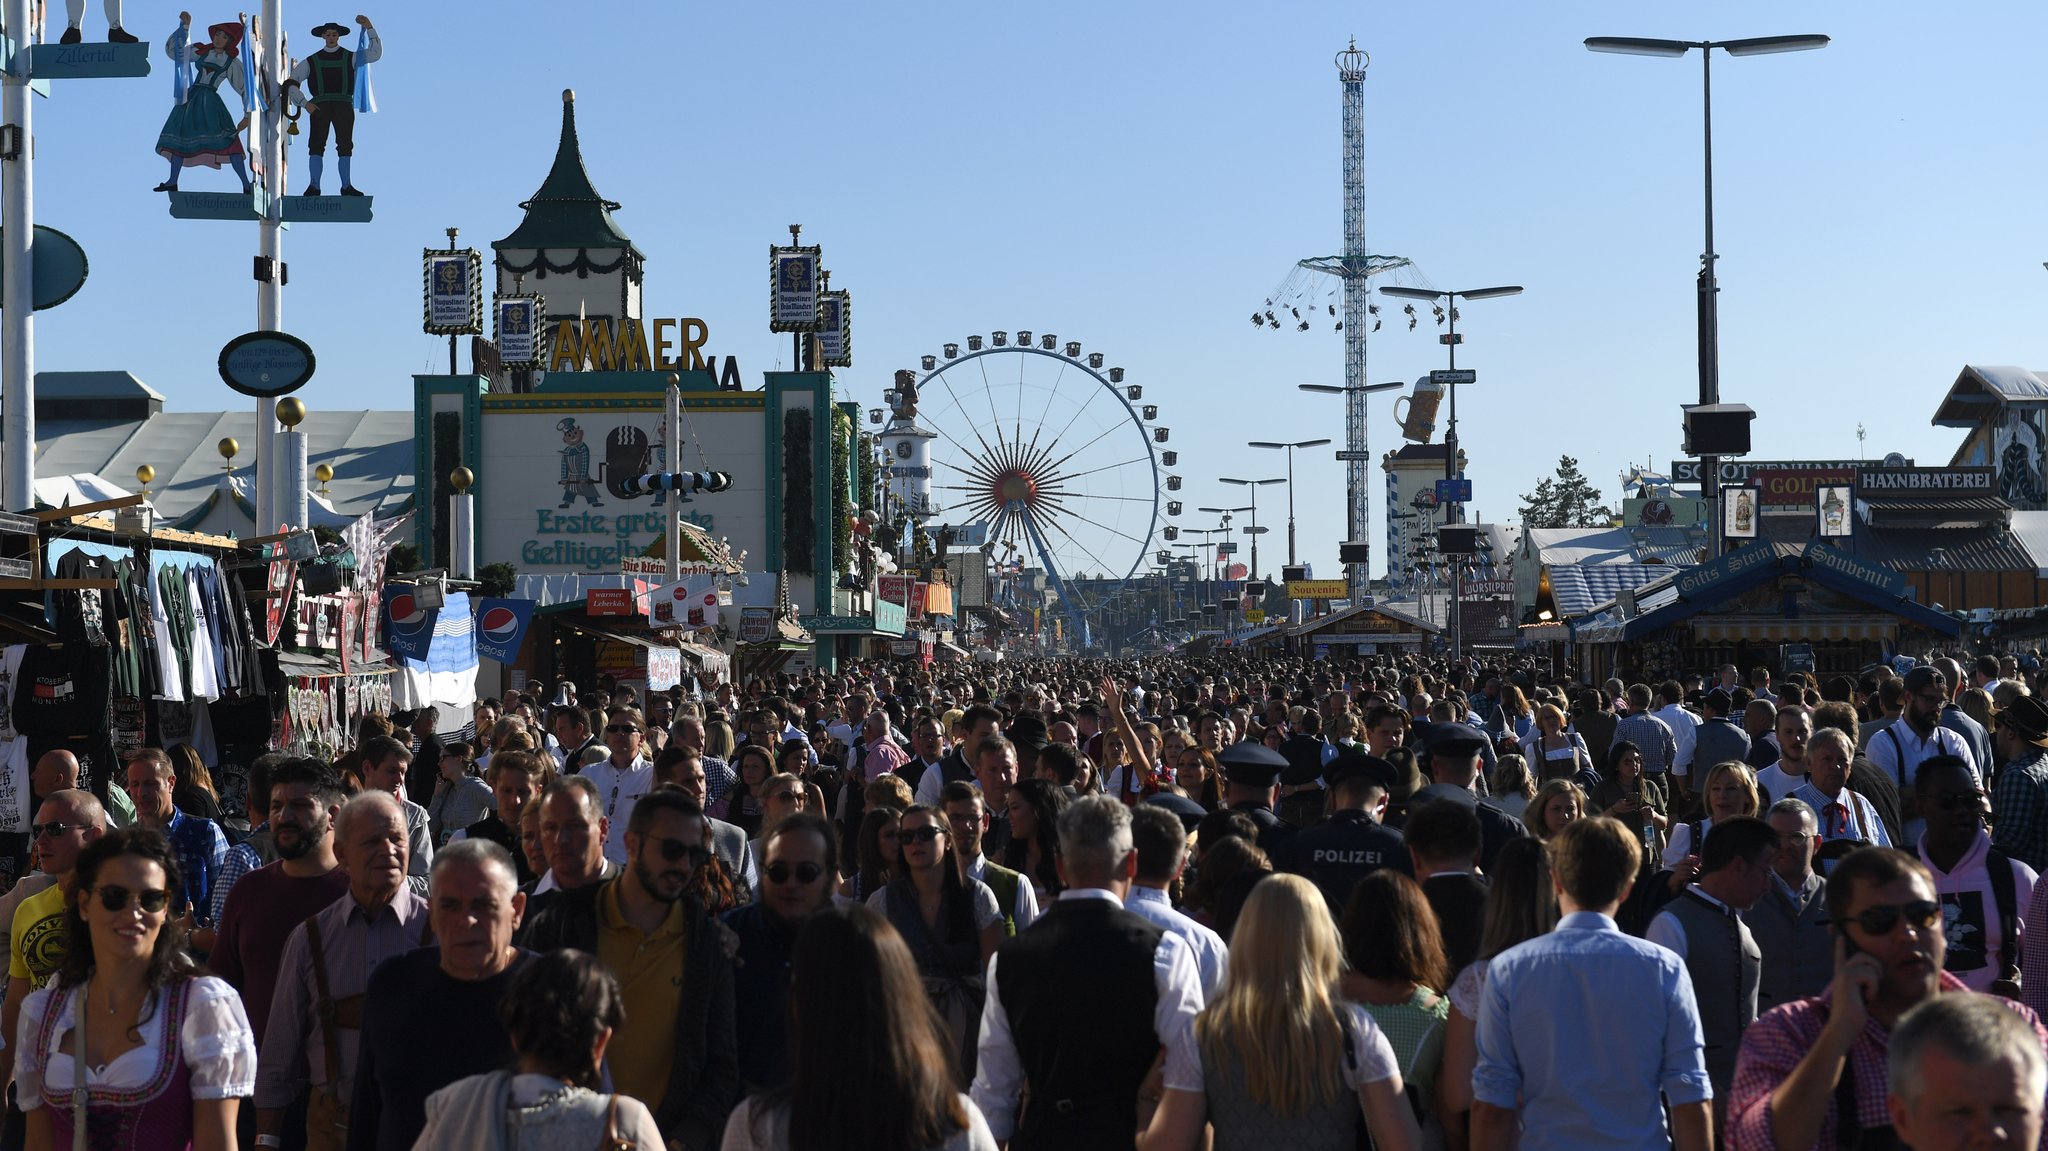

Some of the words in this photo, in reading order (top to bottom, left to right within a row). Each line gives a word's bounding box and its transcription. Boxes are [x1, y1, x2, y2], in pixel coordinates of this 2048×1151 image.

[56, 46, 118, 66] Zillertal
[294, 199, 342, 215] Vilshofen
[550, 318, 709, 370] AMMER
[1862, 472, 1991, 489] HAXNBRATEREI
[536, 509, 610, 535] Erste,
[622, 559, 639, 572] Die
[1681, 566, 1720, 592] Gifts
[1727, 546, 1771, 574] Stein
[1809, 544, 1893, 588] Souvenir
[595, 591, 624, 599] warmer
[1293, 584, 1341, 595] Souvenirs
[593, 600, 626, 608] Leberkäs
[476, 641, 508, 659] pepsi
[1313, 849, 1382, 864] POLIZEI
